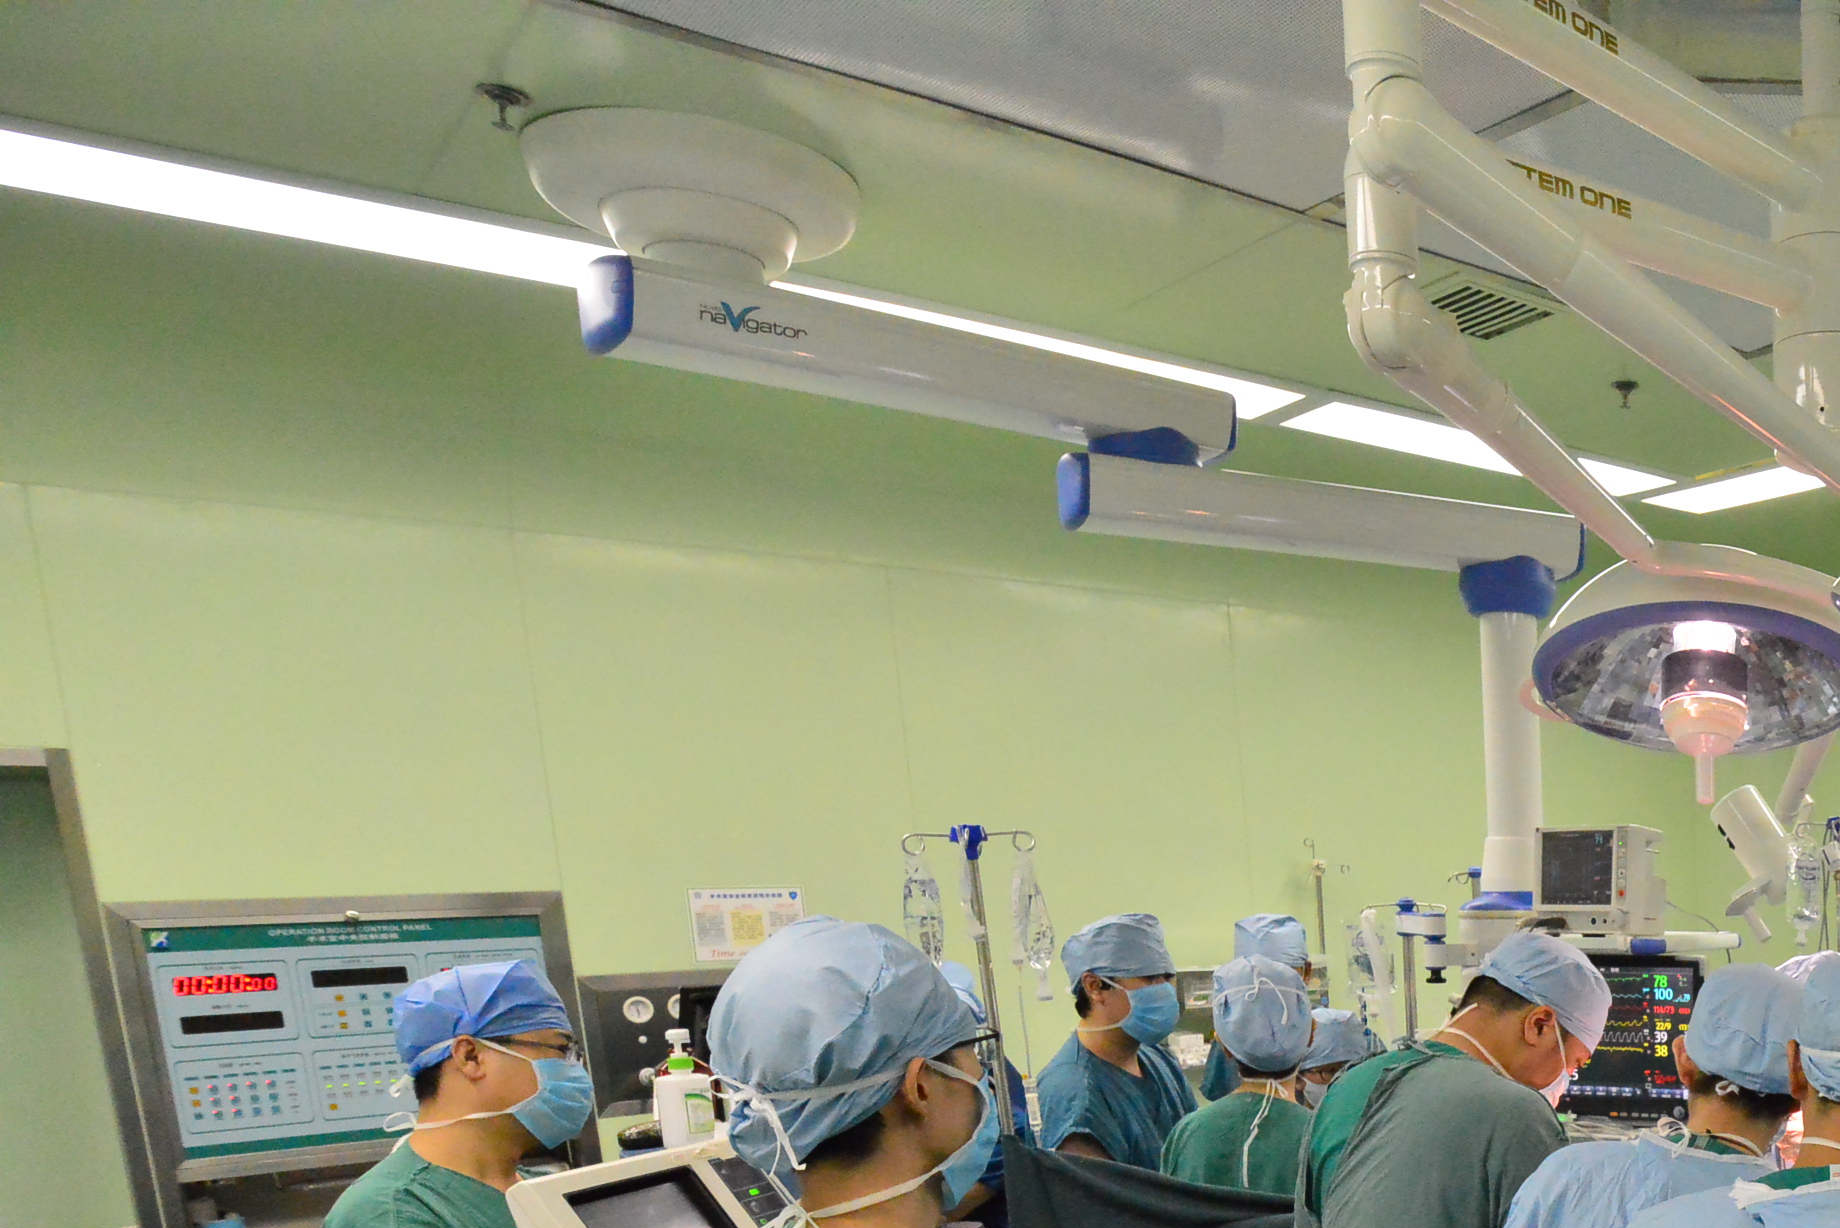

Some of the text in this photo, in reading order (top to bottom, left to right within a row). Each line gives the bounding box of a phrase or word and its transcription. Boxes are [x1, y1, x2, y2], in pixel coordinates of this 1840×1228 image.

[1571, 11, 1619, 55] ONE
[1579, 185, 1632, 220] ONE
[268, 927, 325, 937] OPERATION
[357, 924, 401, 933] CONTROL
[402, 923, 433, 931] PANEL
[173, 973, 278, 996] 00:00:00
[1653, 974, 1668, 988] 78
[1653, 987, 1674, 1001] 100
[1653, 1031, 1668, 1044] 39
[1654, 1044, 1669, 1057] 38
